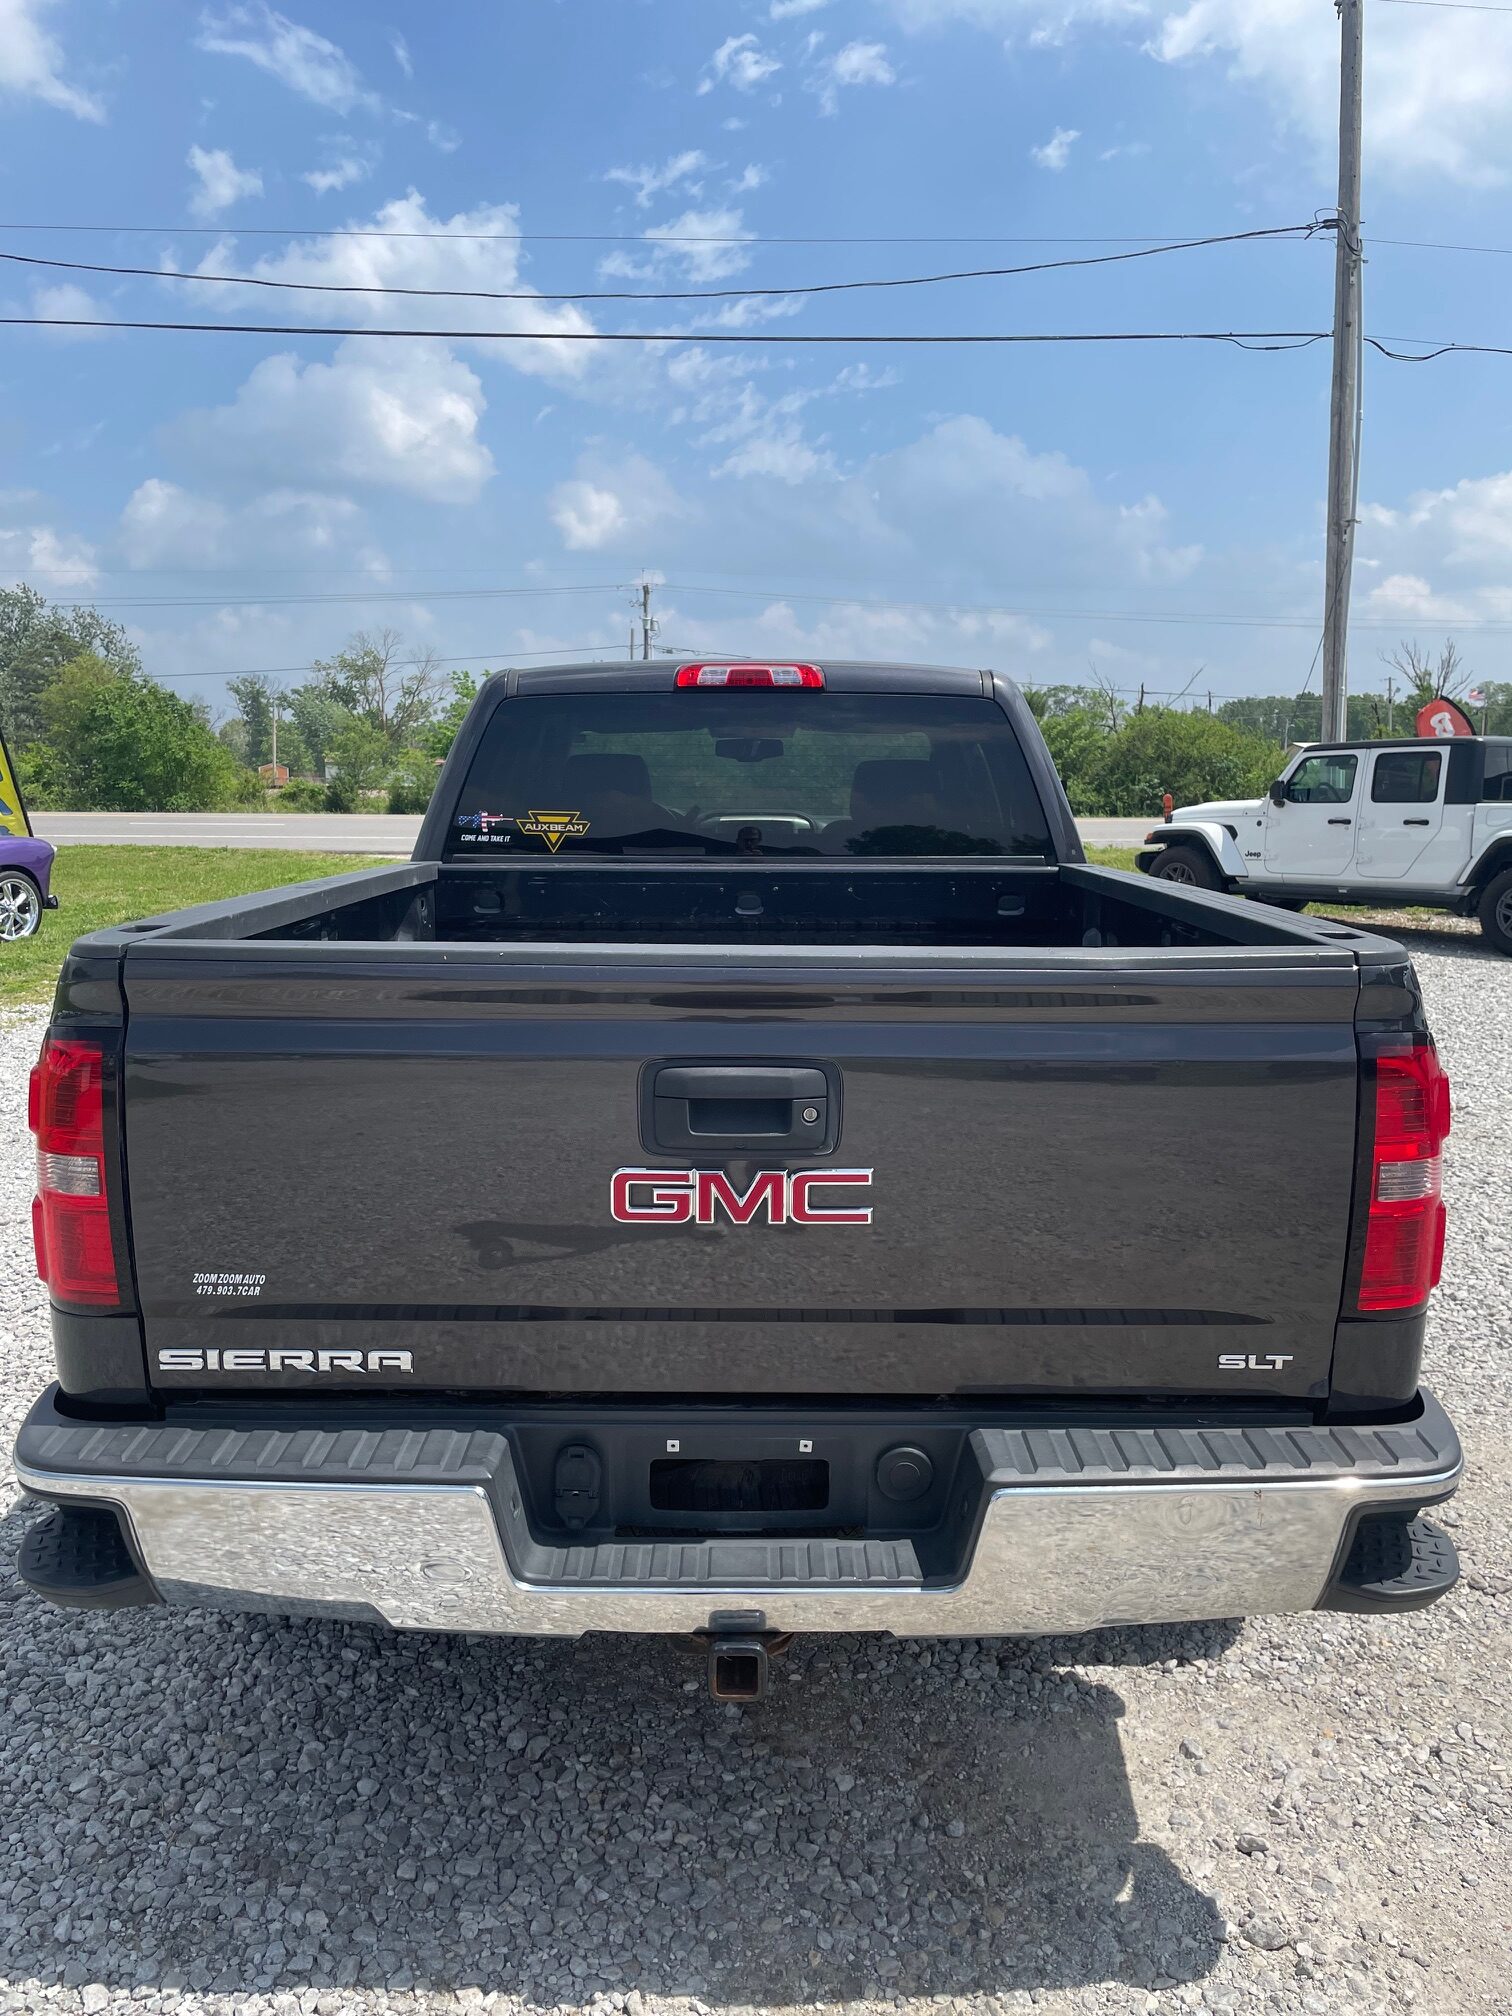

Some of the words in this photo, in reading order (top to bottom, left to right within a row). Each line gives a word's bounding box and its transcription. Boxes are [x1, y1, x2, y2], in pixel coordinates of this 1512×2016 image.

[524, 823, 583, 832] AUXBEAM
[460, 834, 477, 842] COME
[477, 834, 490, 842] AND
[504, 835, 511, 843] IT
[1244, 850, 1262, 859] Jeep
[610, 1166, 875, 1225] GMC
[192, 1273, 218, 1284] ZOOM
[217, 1273, 243, 1284] ZOOM
[242, 1274, 266, 1285] AUTO
[196, 1285, 261, 1296] 479.903.7CAR
[158, 1348, 414, 1374] SIERRA
[1218, 1353, 1294, 1370] SLT
